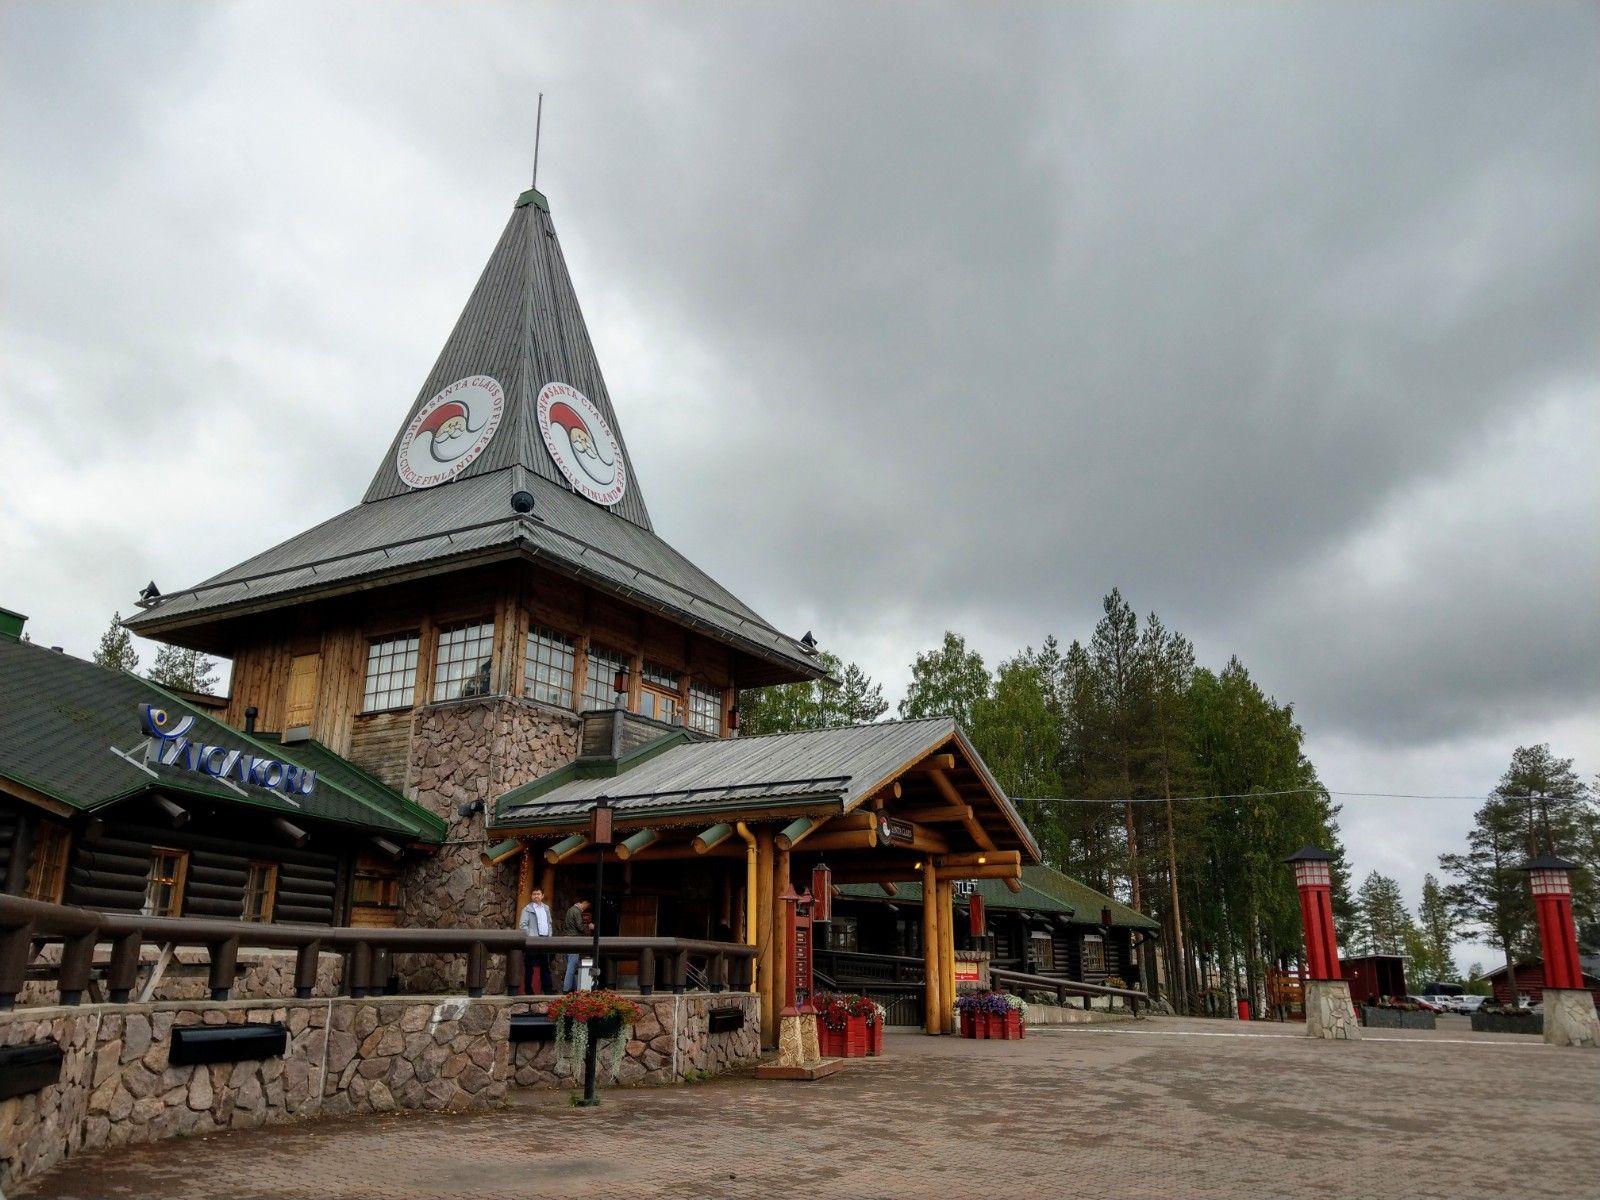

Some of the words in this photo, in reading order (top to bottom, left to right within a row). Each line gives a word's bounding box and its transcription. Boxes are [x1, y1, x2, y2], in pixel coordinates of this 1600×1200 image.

[429, 380, 470, 408] SANTA
[471, 377, 500, 397] CLAUS
[480, 397, 502, 444] OFFICE
[548, 385, 579, 401] SANTA
[580, 398, 611, 437] CLAUS
[400, 416, 422, 459] ARCTIC
[400, 458, 423, 485] CIRCLE
[421, 453, 473, 486] FINLAND
[548, 442, 581, 487] CIRCLE
[581, 484, 620, 504] FINLAND
[146, 704, 317, 796] TAIGAKORU
